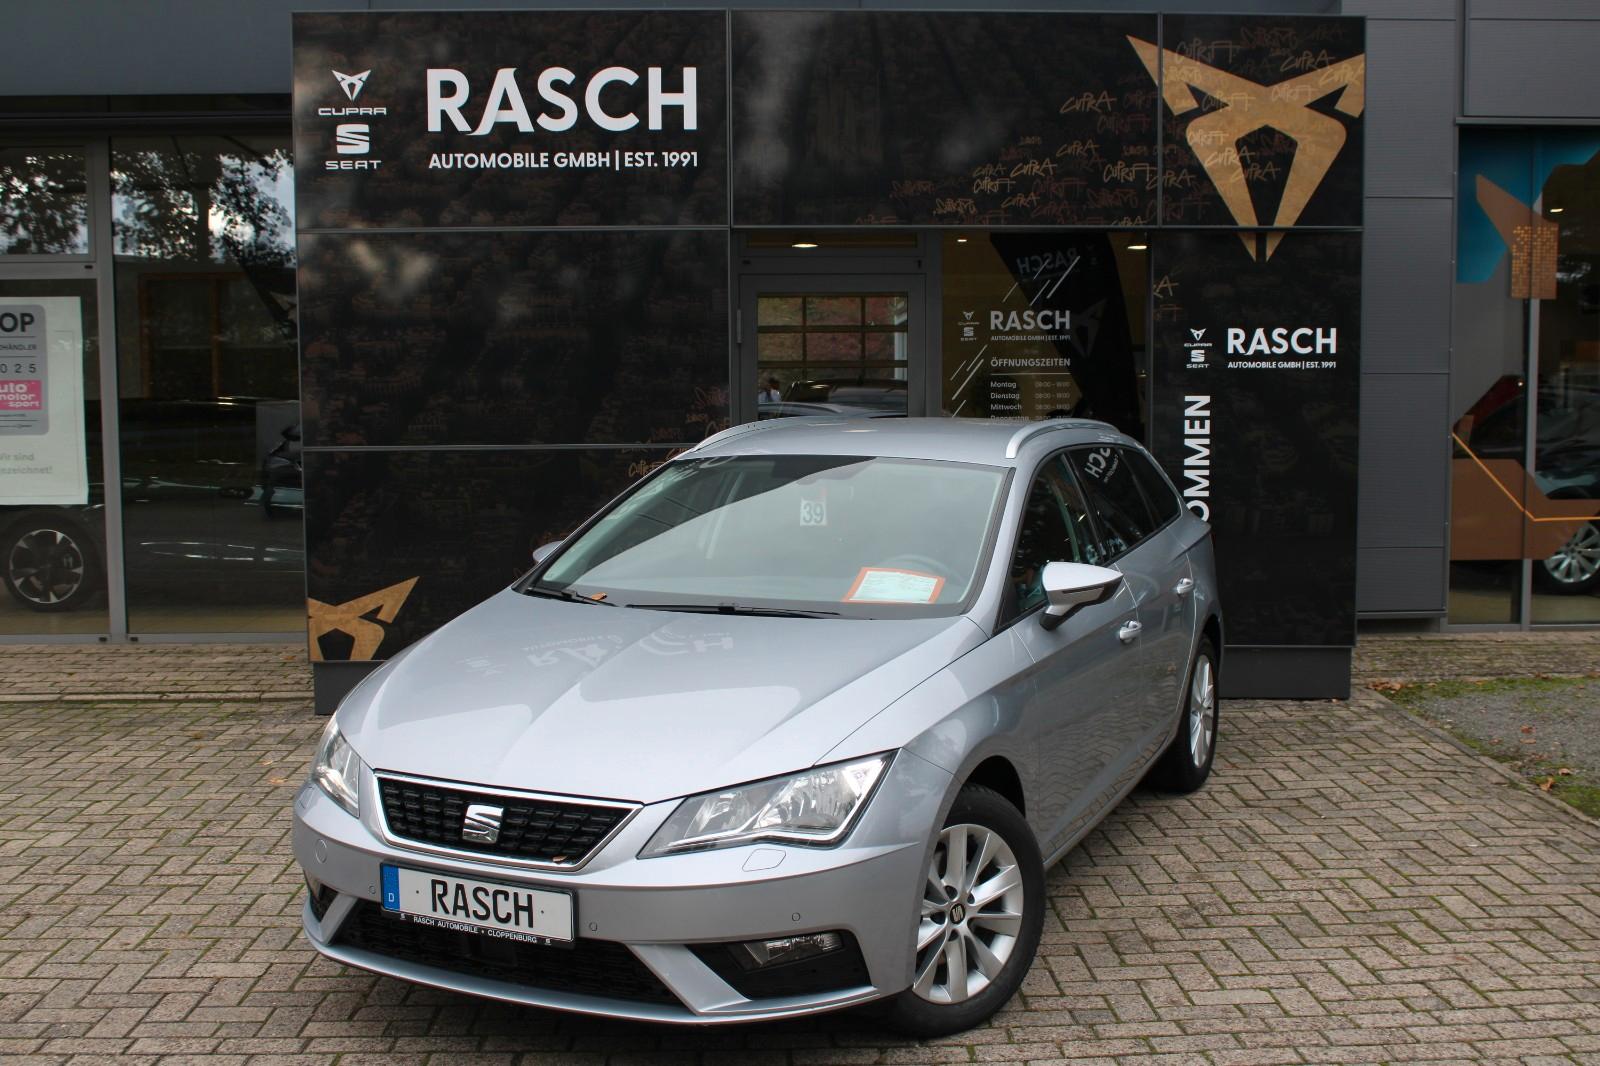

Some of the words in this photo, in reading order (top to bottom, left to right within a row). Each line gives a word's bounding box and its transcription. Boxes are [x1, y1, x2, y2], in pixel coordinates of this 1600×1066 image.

[426, 66, 698, 136] RASCH
[317, 107, 387, 116] CUPRA
[325, 160, 382, 170] SEAT
[428, 152, 549, 169] AUTOMOBILE
[554, 152, 610, 168] GMBH
[624, 152, 658, 168] EST.
[663, 151, 698, 167] 1991
[990, 310, 1071, 331] RASCH
[1227, 327, 1337, 356] RASCH
[990, 356, 1071, 367] ÖFFNUNGSZEITEN
[1227, 361, 1277, 369] AUTOMOBILE
[1306, 361, 1320, 369] EST.
[1321, 361, 1336, 369] 1991
[990, 381, 1017, 389] Montag
[990, 392, 1020, 400] Dienstag
[802, 502, 824, 525] 39
[388, 892, 395, 903] D
[431, 878, 534, 929] RASCH
[413, 916, 435, 926] RASCH
[437, 920, 479, 934] AUTOMOBILE
[487, 929, 538, 943] CLOPPENBURG
